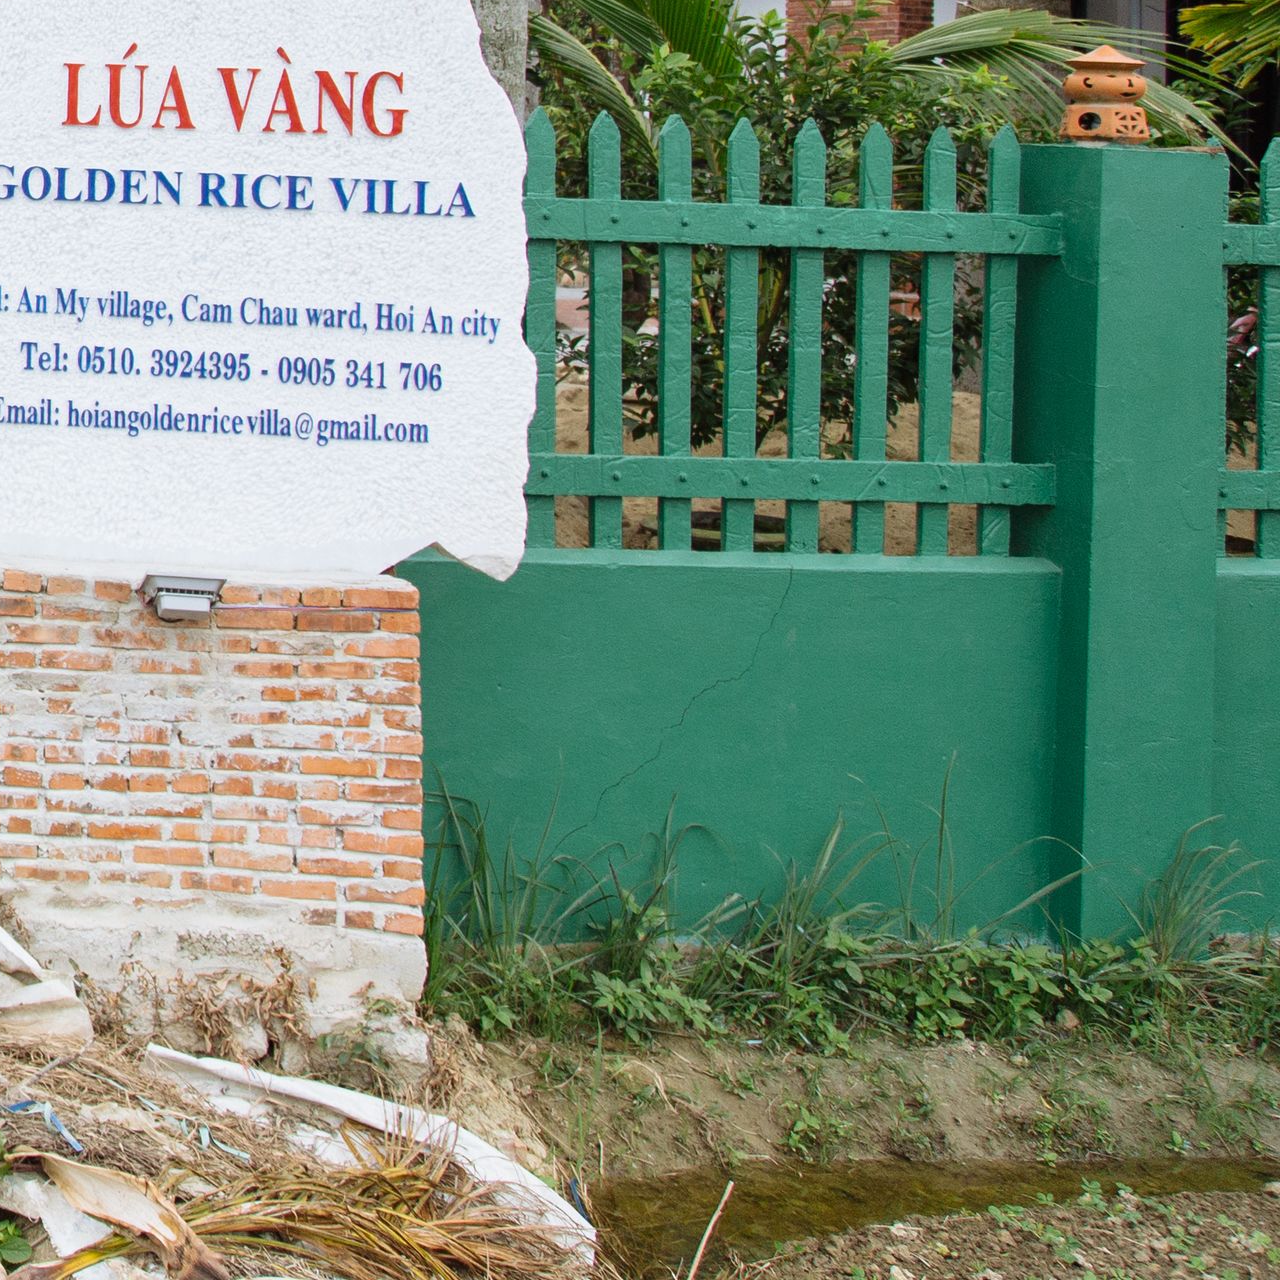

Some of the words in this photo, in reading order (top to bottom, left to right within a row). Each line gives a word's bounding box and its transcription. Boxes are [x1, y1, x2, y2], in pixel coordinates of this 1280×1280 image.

[62, 43, 196, 130] LÚA
[218, 48, 409, 138] VÀNG
[198, 173, 315, 210] RICE
[330, 177, 475, 218] VILLA
[16, 286, 48, 314] An
[55, 288, 89, 322] My
[98, 291, 174, 327] village,
[181, 294, 233, 324] Cam
[239, 297, 299, 326] Chau
[306, 303, 368, 335] ward,
[376, 304, 415, 332] Hoi
[422, 307, 454, 335] An
[460, 309, 501, 344] city
[21, 341, 69, 372] Tel:
[77, 346, 141, 376] 0510.
[150, 351, 251, 383] 3924395
[278, 357, 336, 386] 0905
[345, 360, 387, 390] 341
[400, 363, 444, 392] 706
